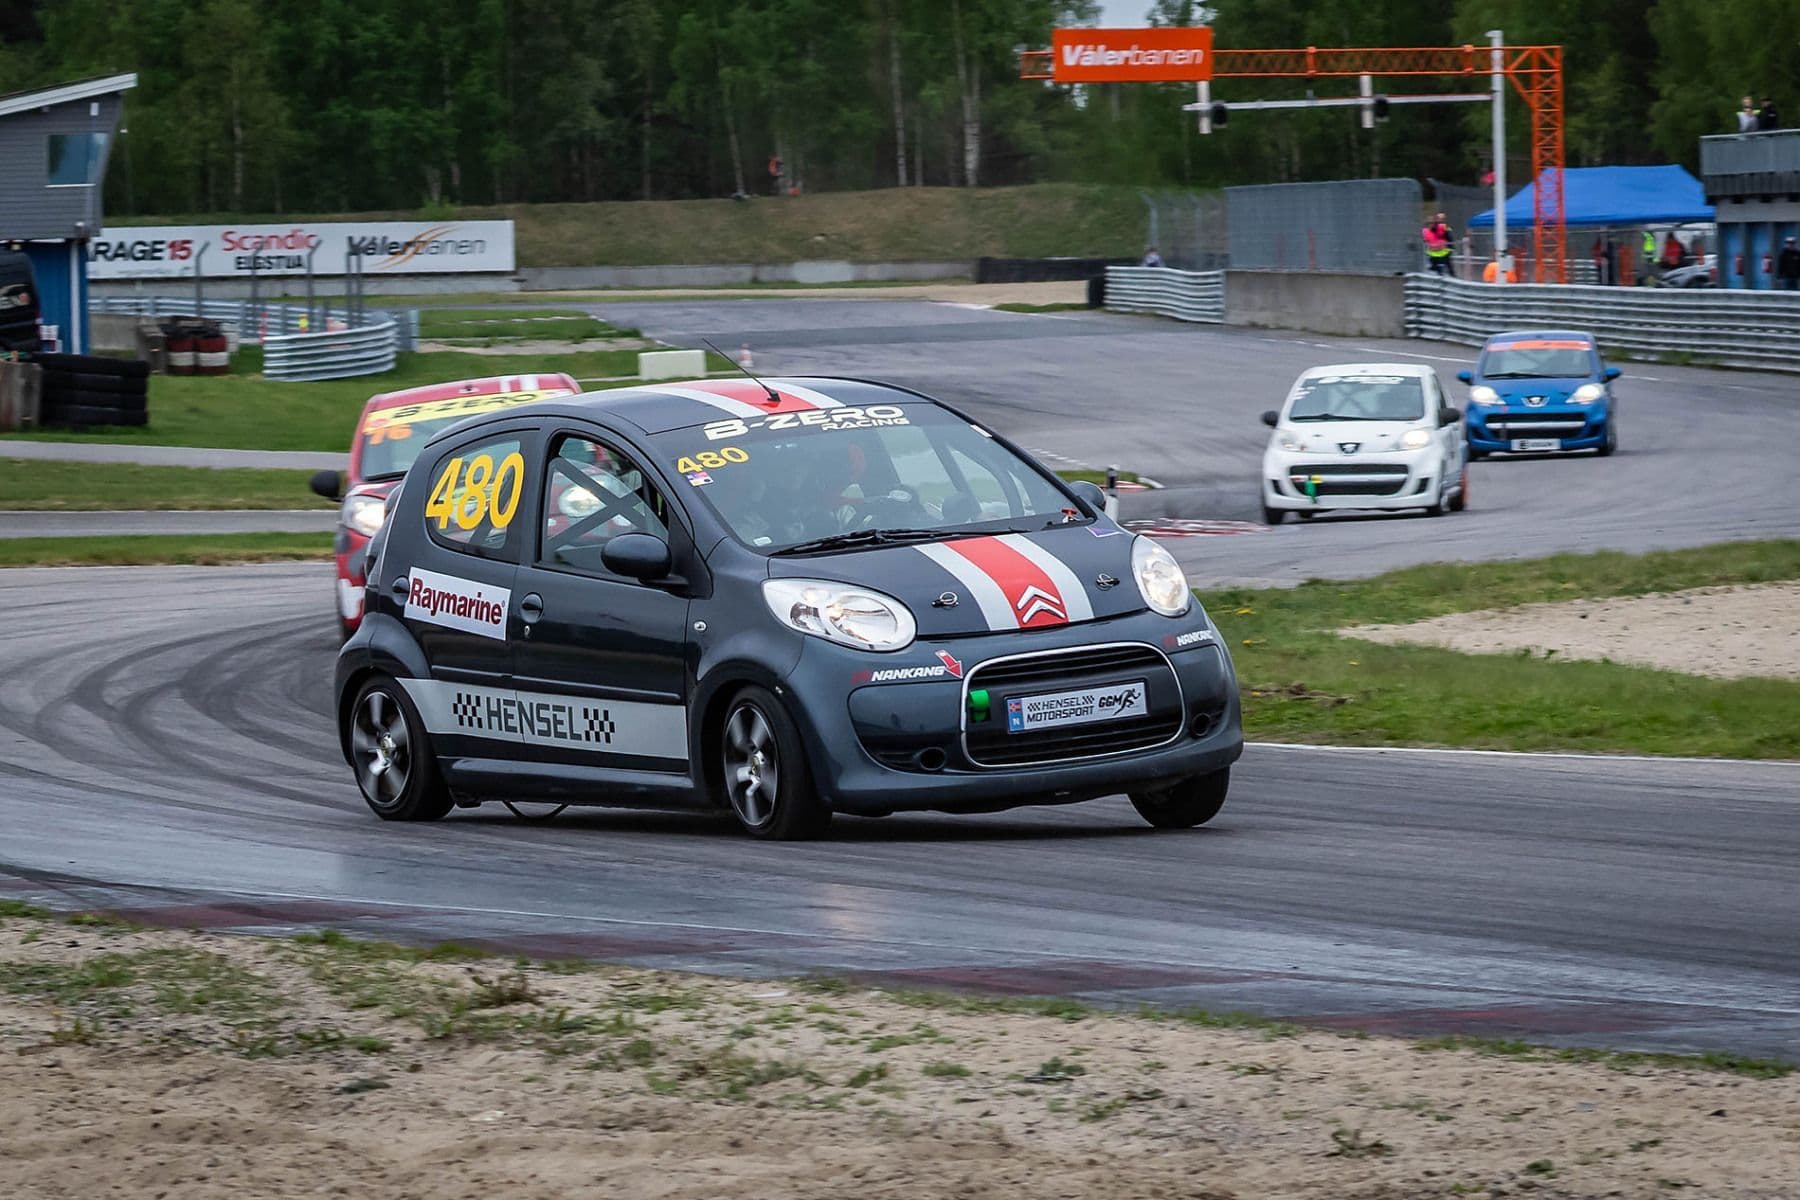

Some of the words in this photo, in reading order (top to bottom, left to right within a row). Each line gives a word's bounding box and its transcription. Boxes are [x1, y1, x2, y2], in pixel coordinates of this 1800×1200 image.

[222, 229, 318, 251] Scandic
[703, 406, 905, 441] B-ZERO
[821, 416, 911, 431] RACING
[677, 447, 749, 474] 480
[425, 452, 525, 530] 480
[409, 577, 506, 625] Raymarine
[871, 665, 946, 682] NANKANG
[1026, 705, 1095, 723] MOTORSPORT
[1041, 697, 1083, 713] HENSEL
[486, 696, 583, 741] HENSEL
